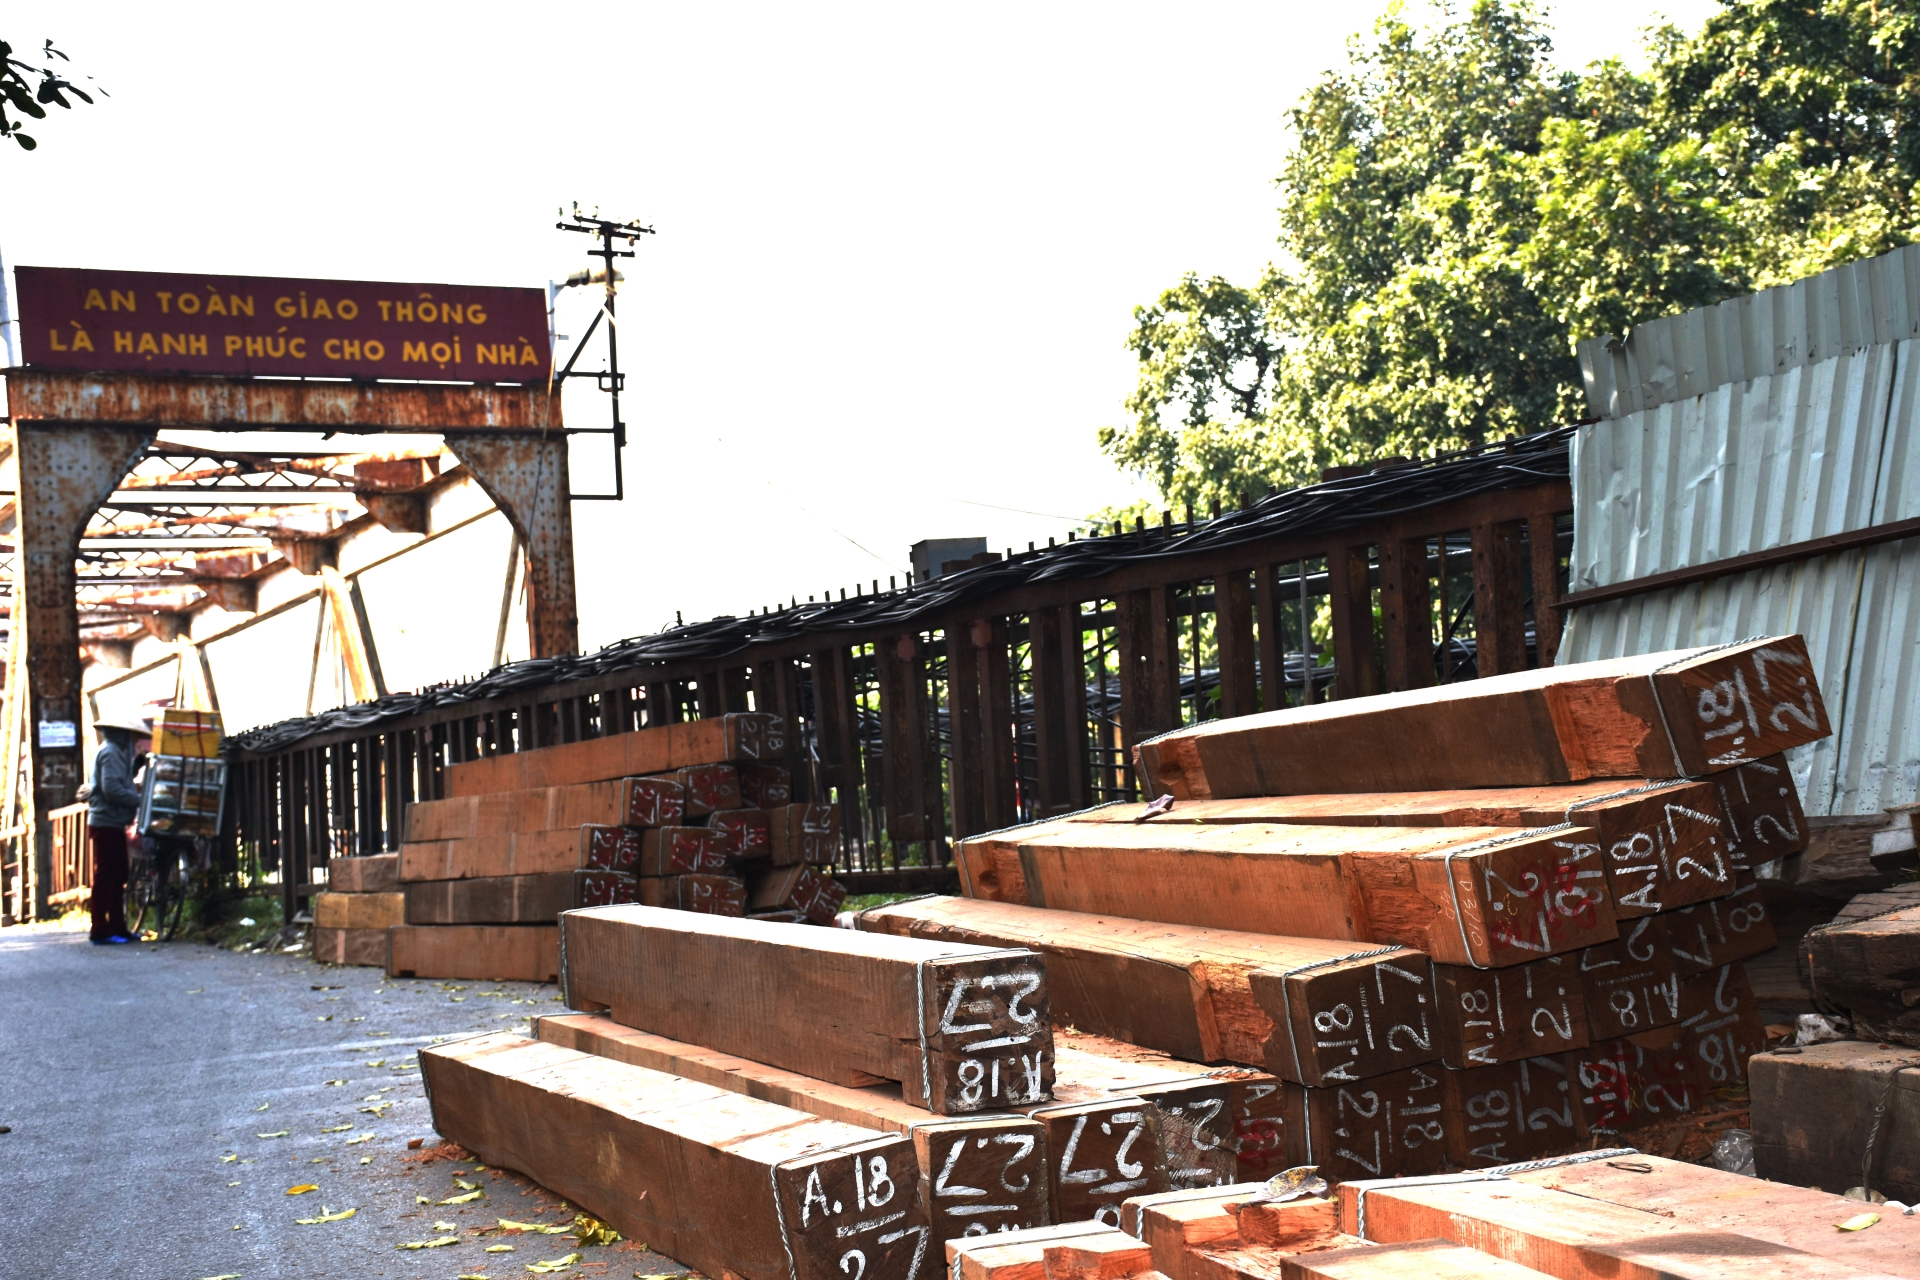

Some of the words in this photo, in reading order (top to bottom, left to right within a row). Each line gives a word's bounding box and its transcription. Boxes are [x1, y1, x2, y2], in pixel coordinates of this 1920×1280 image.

[84, 288, 136, 312] AN
[156, 284, 255, 317] TOÀN
[376, 292, 488, 326] THÔNG
[49, 321, 95, 352] LÀ
[114, 330, 208, 361] HẠNH
[224, 326, 307, 360] PHÚC
[322, 338, 386, 362] CHO
[476, 336, 540, 367] NHÀ
[1752, 648, 1820, 732] 2.7
[740, 718, 760, 760] 2.7
[1610, 832, 1664, 913] A.18
[1664, 804, 1731, 882] 2.7
[940, 970, 1042, 1035] 2.7
[1375, 962, 1432, 1052] 2.7
[1461, 988, 1499, 1065] A.18
[1608, 971, 1679, 1028] A.18
[1314, 1003, 1360, 1081] A.18
[1336, 1088, 1381, 1176] 2.7
[1400, 1066, 1444, 1149] A.18
[1467, 1089, 1510, 1163] A.18
[935, 1133, 1035, 1197] 2.7
[1060, 1111, 1147, 1184] 2.7
[802, 1153, 896, 1229] A.18
